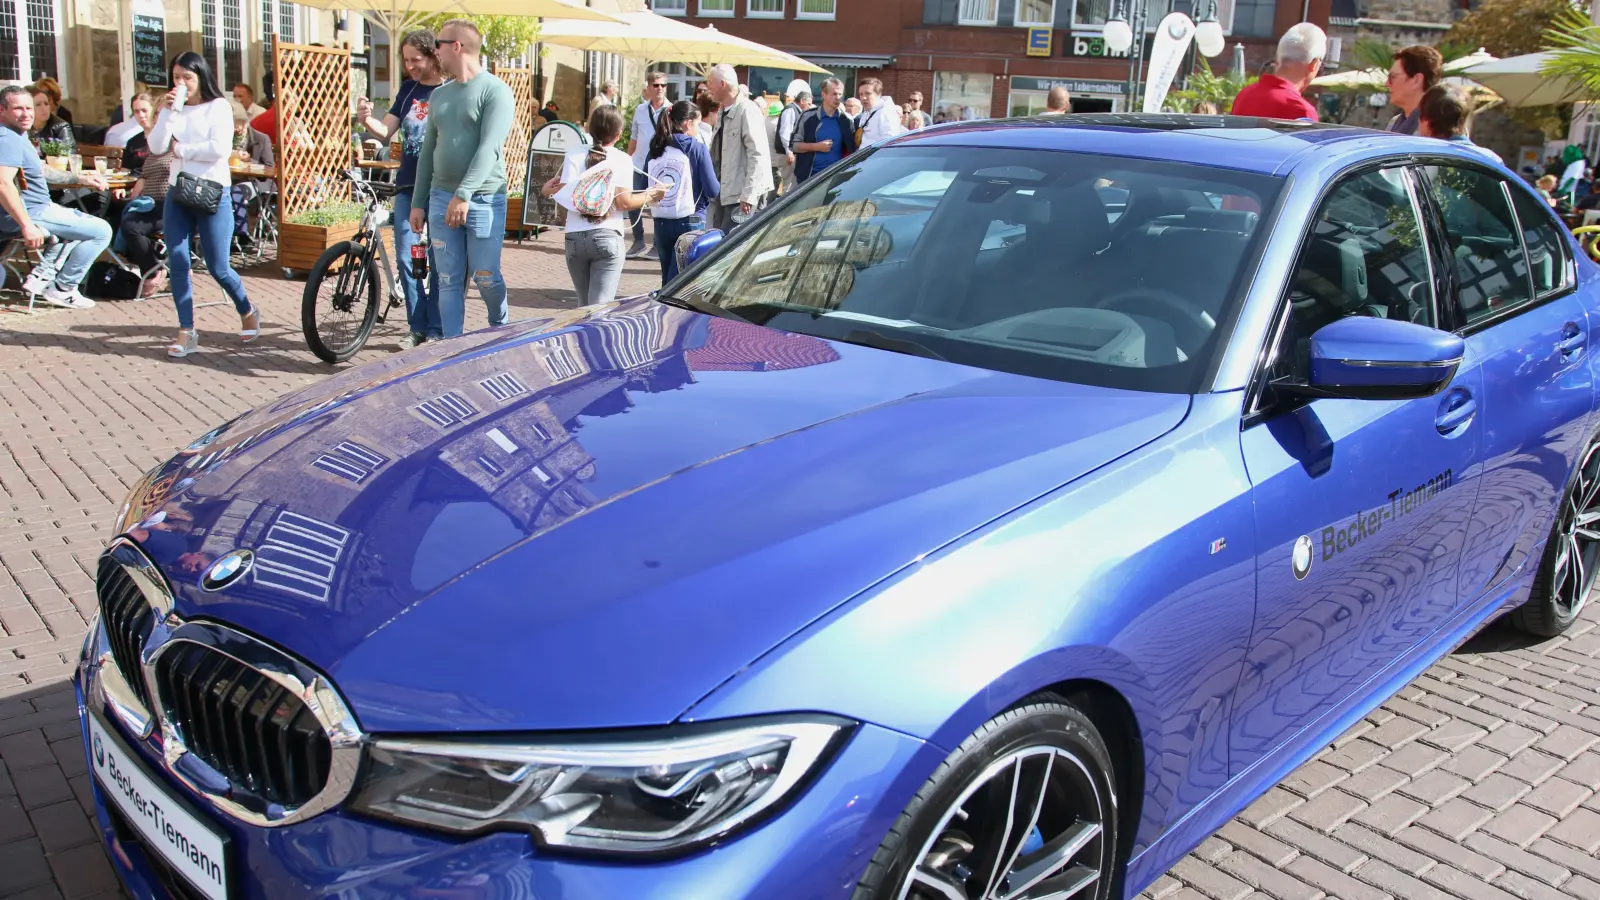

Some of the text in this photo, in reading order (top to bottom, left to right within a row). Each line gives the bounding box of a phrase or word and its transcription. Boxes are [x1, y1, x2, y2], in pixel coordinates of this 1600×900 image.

[1037, 79, 1050, 90] Wir
[1322, 468, 1452, 562] Becker-Tiemann
[108, 752, 222, 886] Becker-Tiemann
